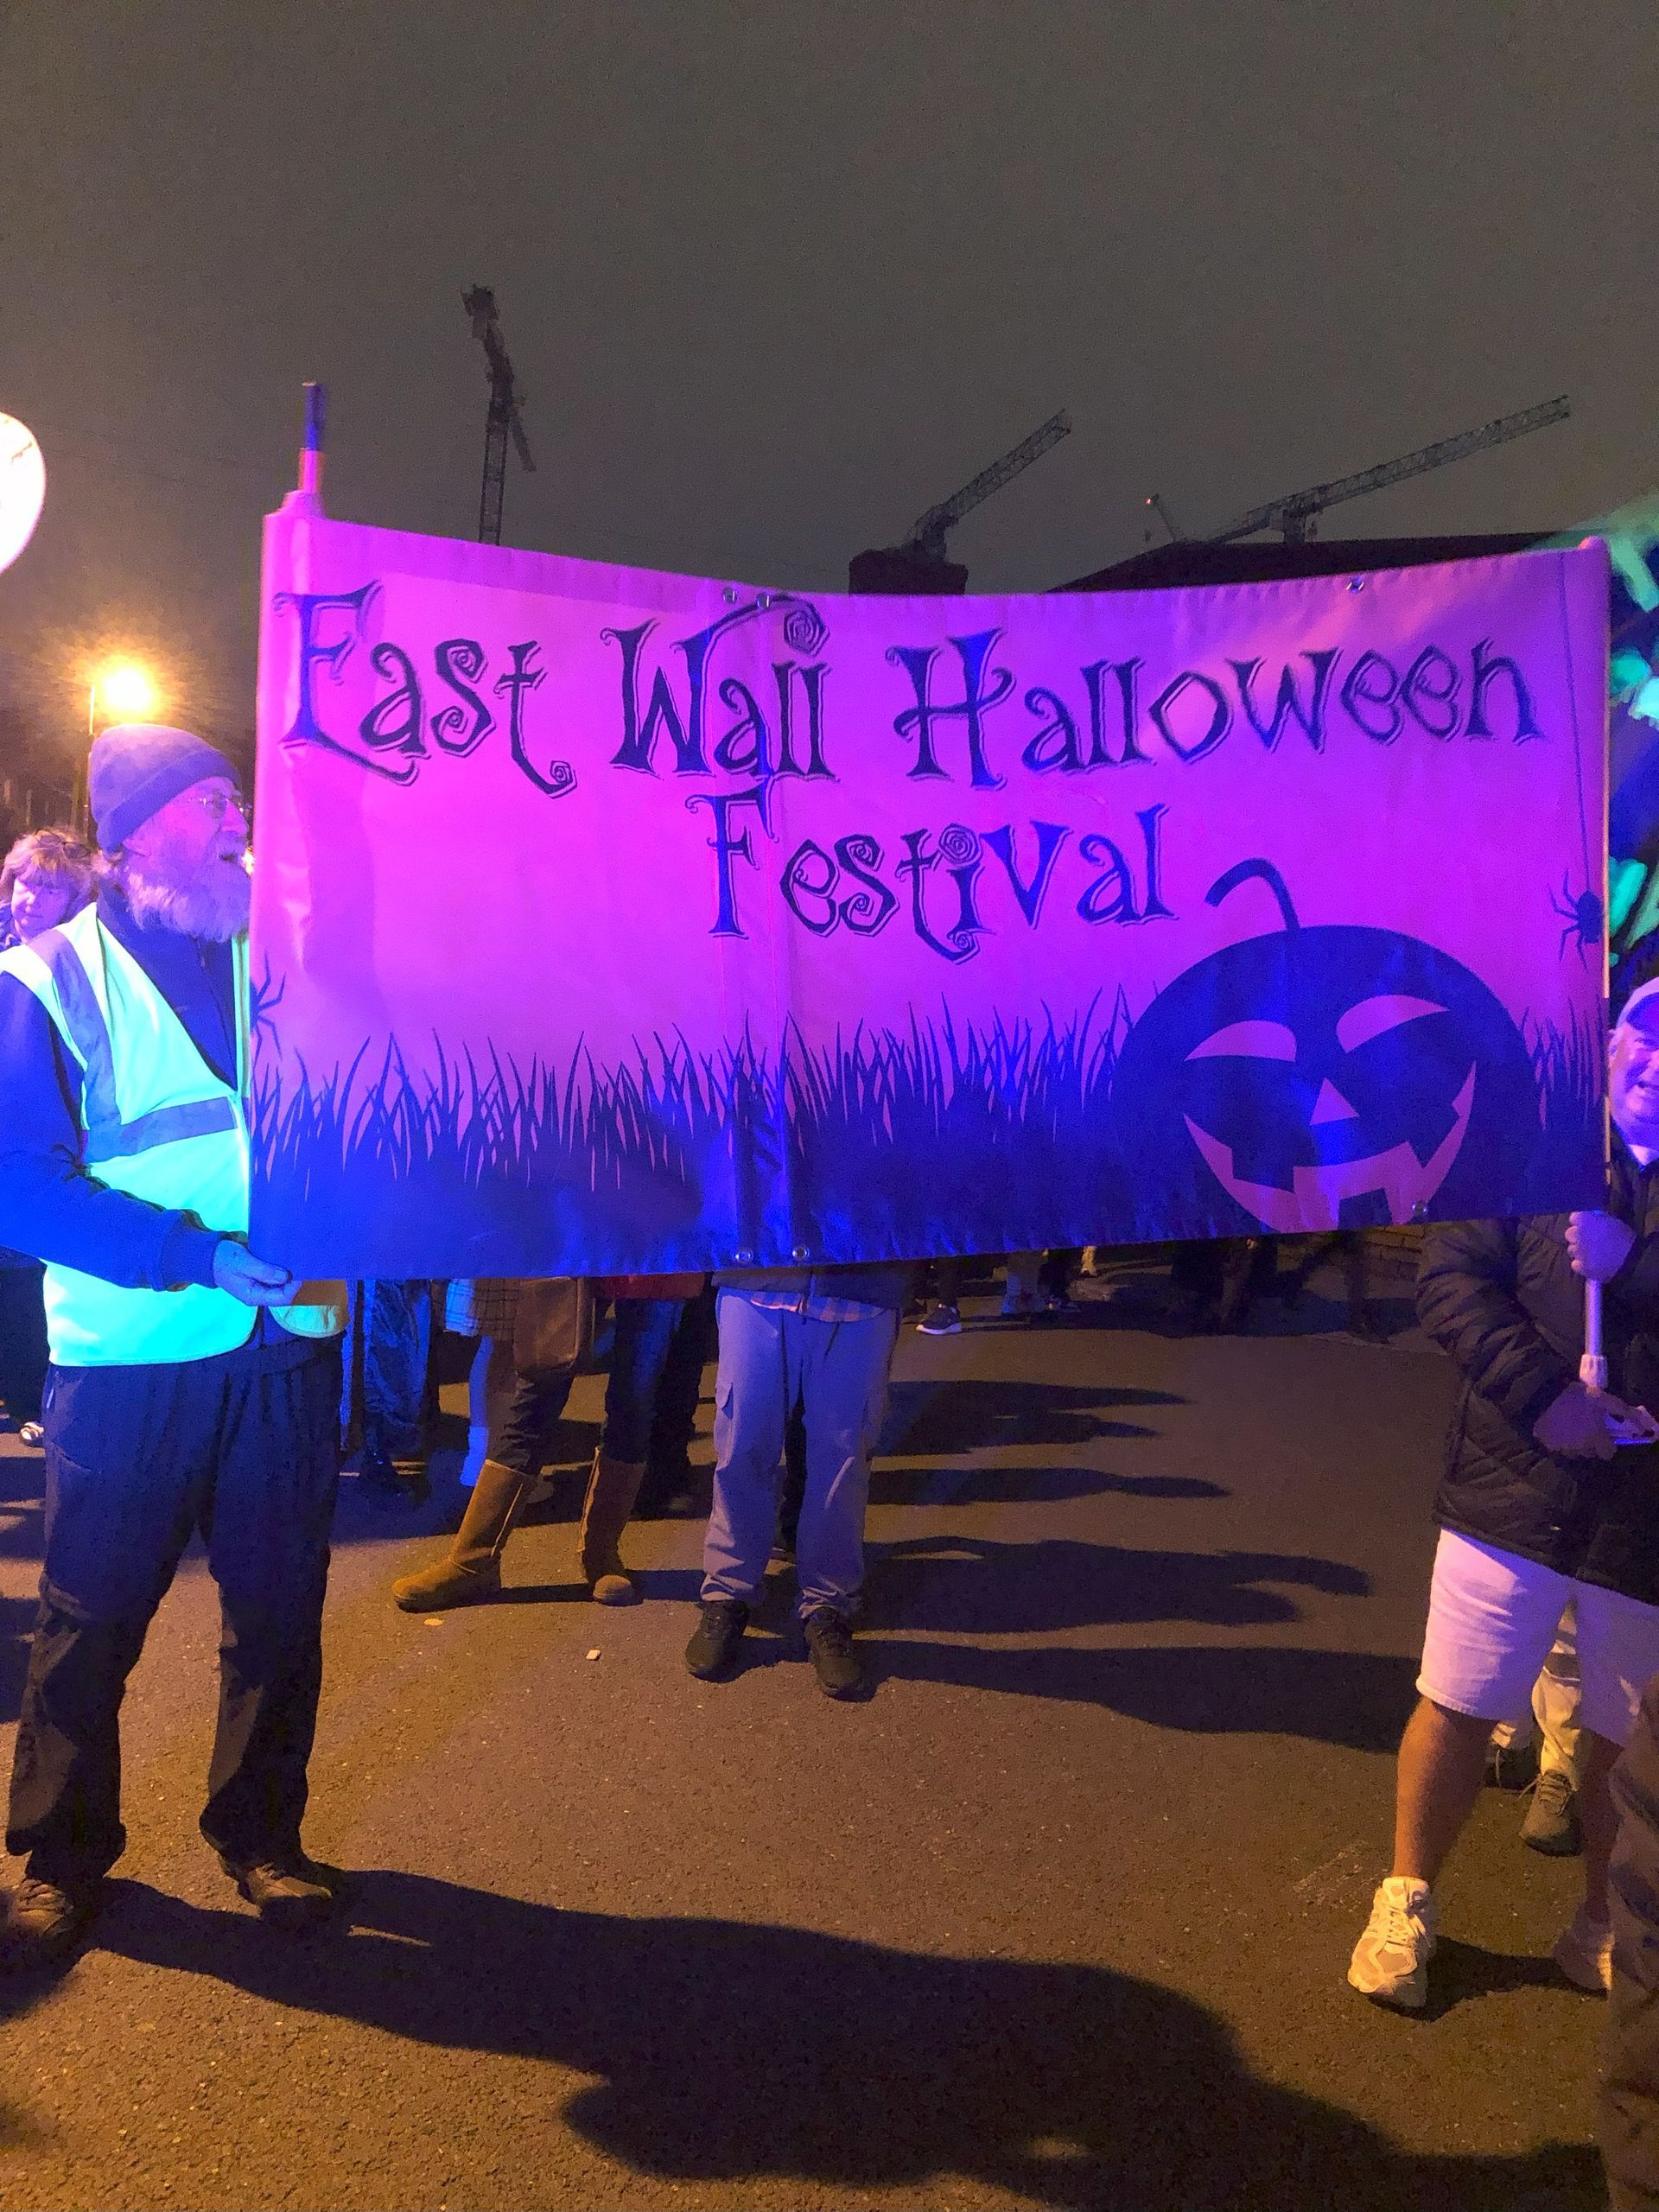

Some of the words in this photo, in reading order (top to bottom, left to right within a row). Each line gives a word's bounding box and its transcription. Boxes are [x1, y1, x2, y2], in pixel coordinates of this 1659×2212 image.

[273, 580, 577, 798] East
[600, 596, 841, 781] Wall
[887, 627, 1545, 789] Halloween
[685, 782, 1177, 963] Festival
